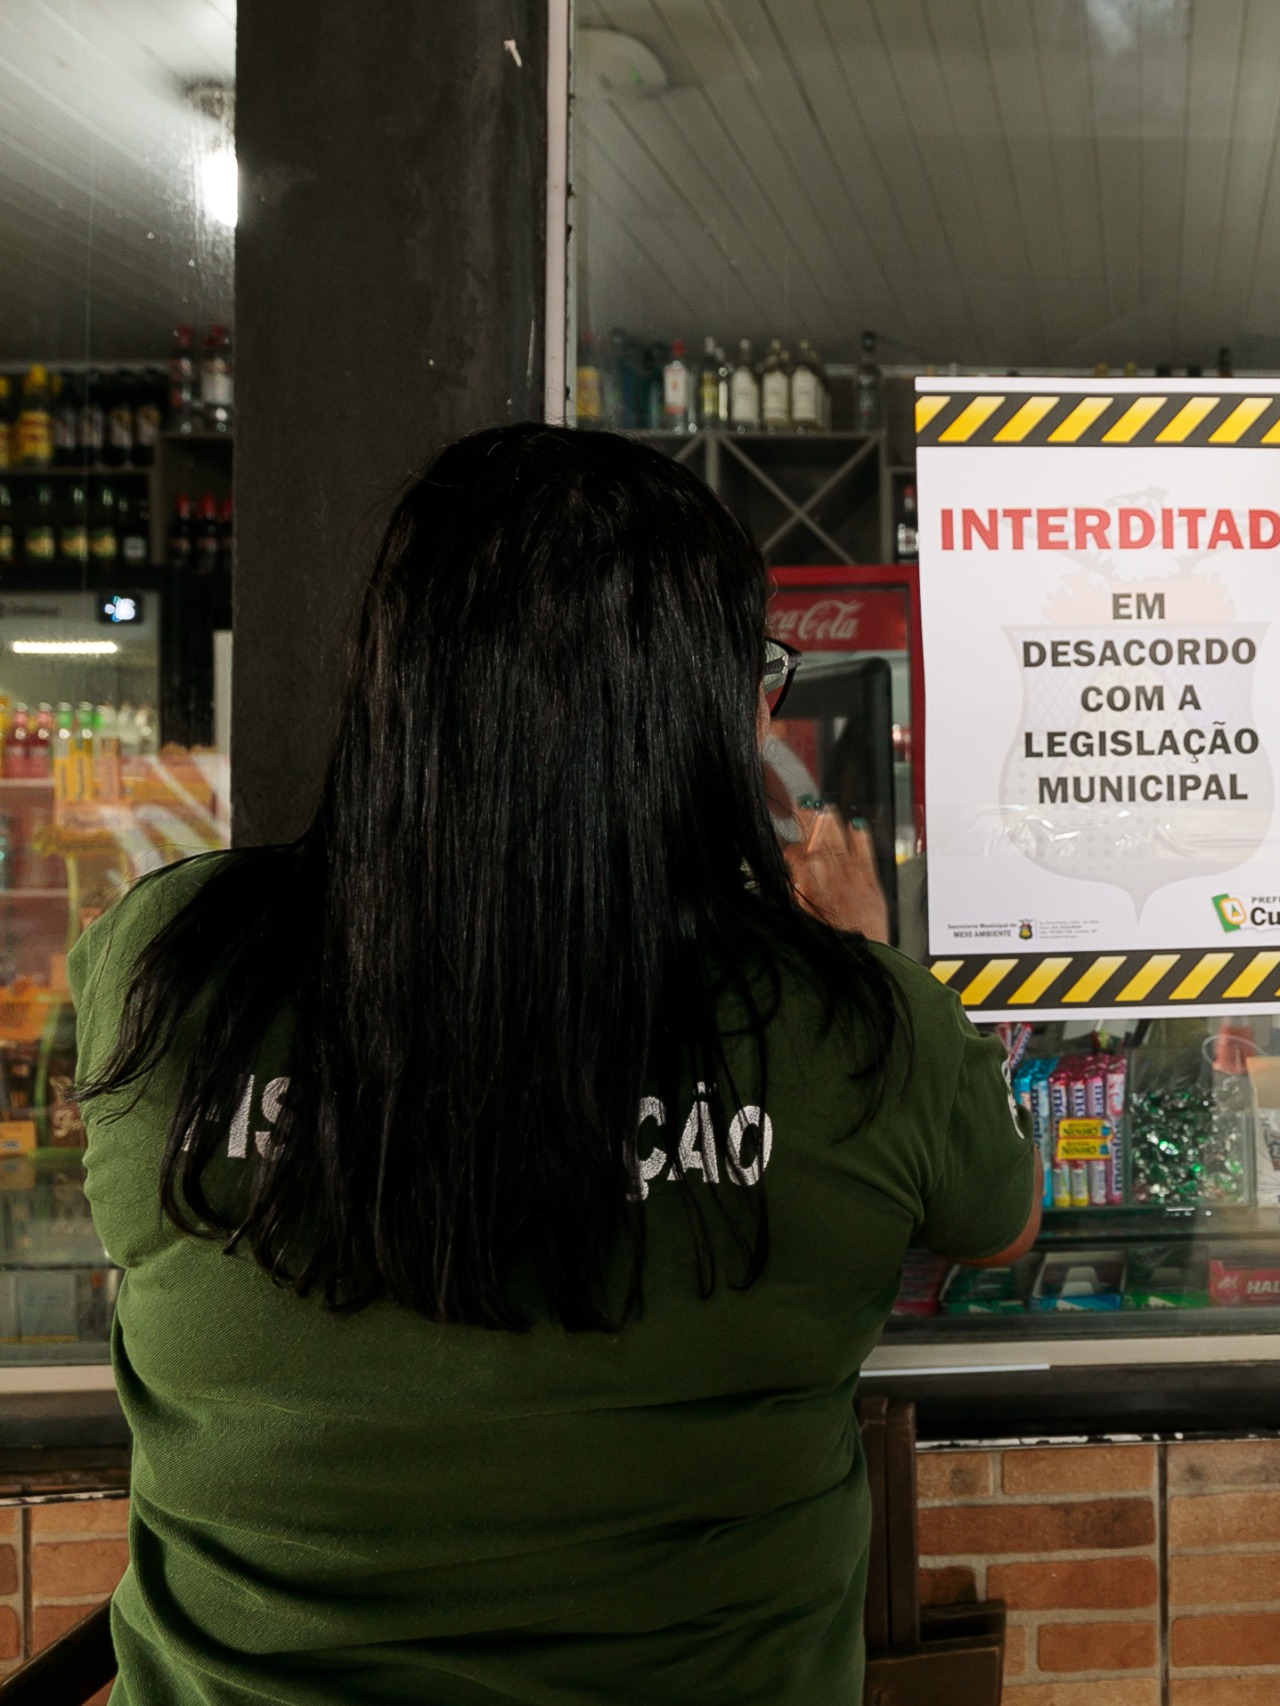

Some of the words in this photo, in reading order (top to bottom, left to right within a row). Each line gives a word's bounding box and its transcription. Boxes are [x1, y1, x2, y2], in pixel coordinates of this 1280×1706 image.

[1112, 592, 1165, 620] EM
[1022, 637, 1257, 667] DESACORDO
[1081, 685, 1165, 712] COM
[1178, 684, 1202, 711] A
[1024, 721, 1259, 763] LEGISLAÇÃO
[1038, 773, 1248, 804] MUNICIPAL
[974, 929, 1011, 937] AMBIENTE
